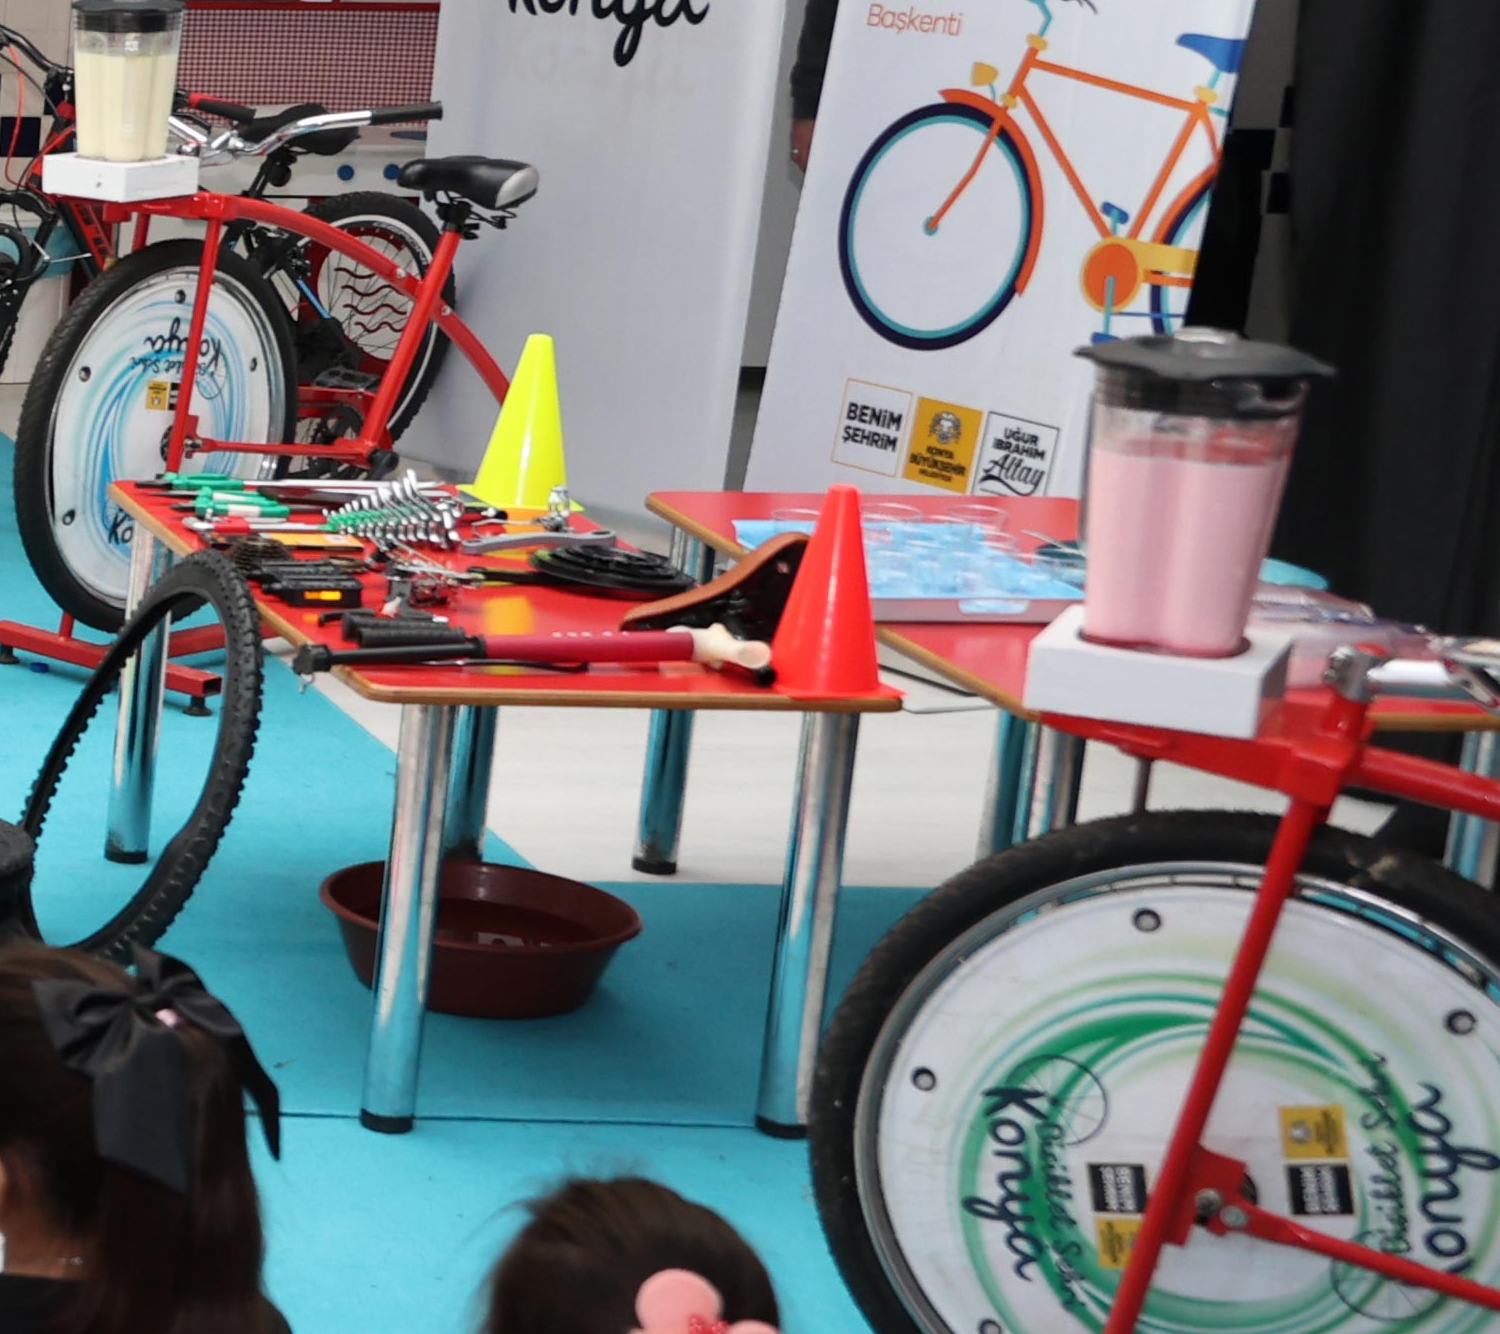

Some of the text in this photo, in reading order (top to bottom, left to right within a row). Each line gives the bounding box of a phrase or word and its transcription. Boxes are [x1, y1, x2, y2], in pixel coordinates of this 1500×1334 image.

[866, 4, 963, 37] Başkenti
[143, 316, 222, 371] Koya
[846, 402, 903, 432] BENİM
[841, 425, 898, 453] ŞEHRİM
[1003, 426, 1040, 445] UĞUR
[983, 453, 1046, 490] Altay
[961, 1086, 1049, 1283] Konya
[1407, 1082, 1500, 1275] onya
